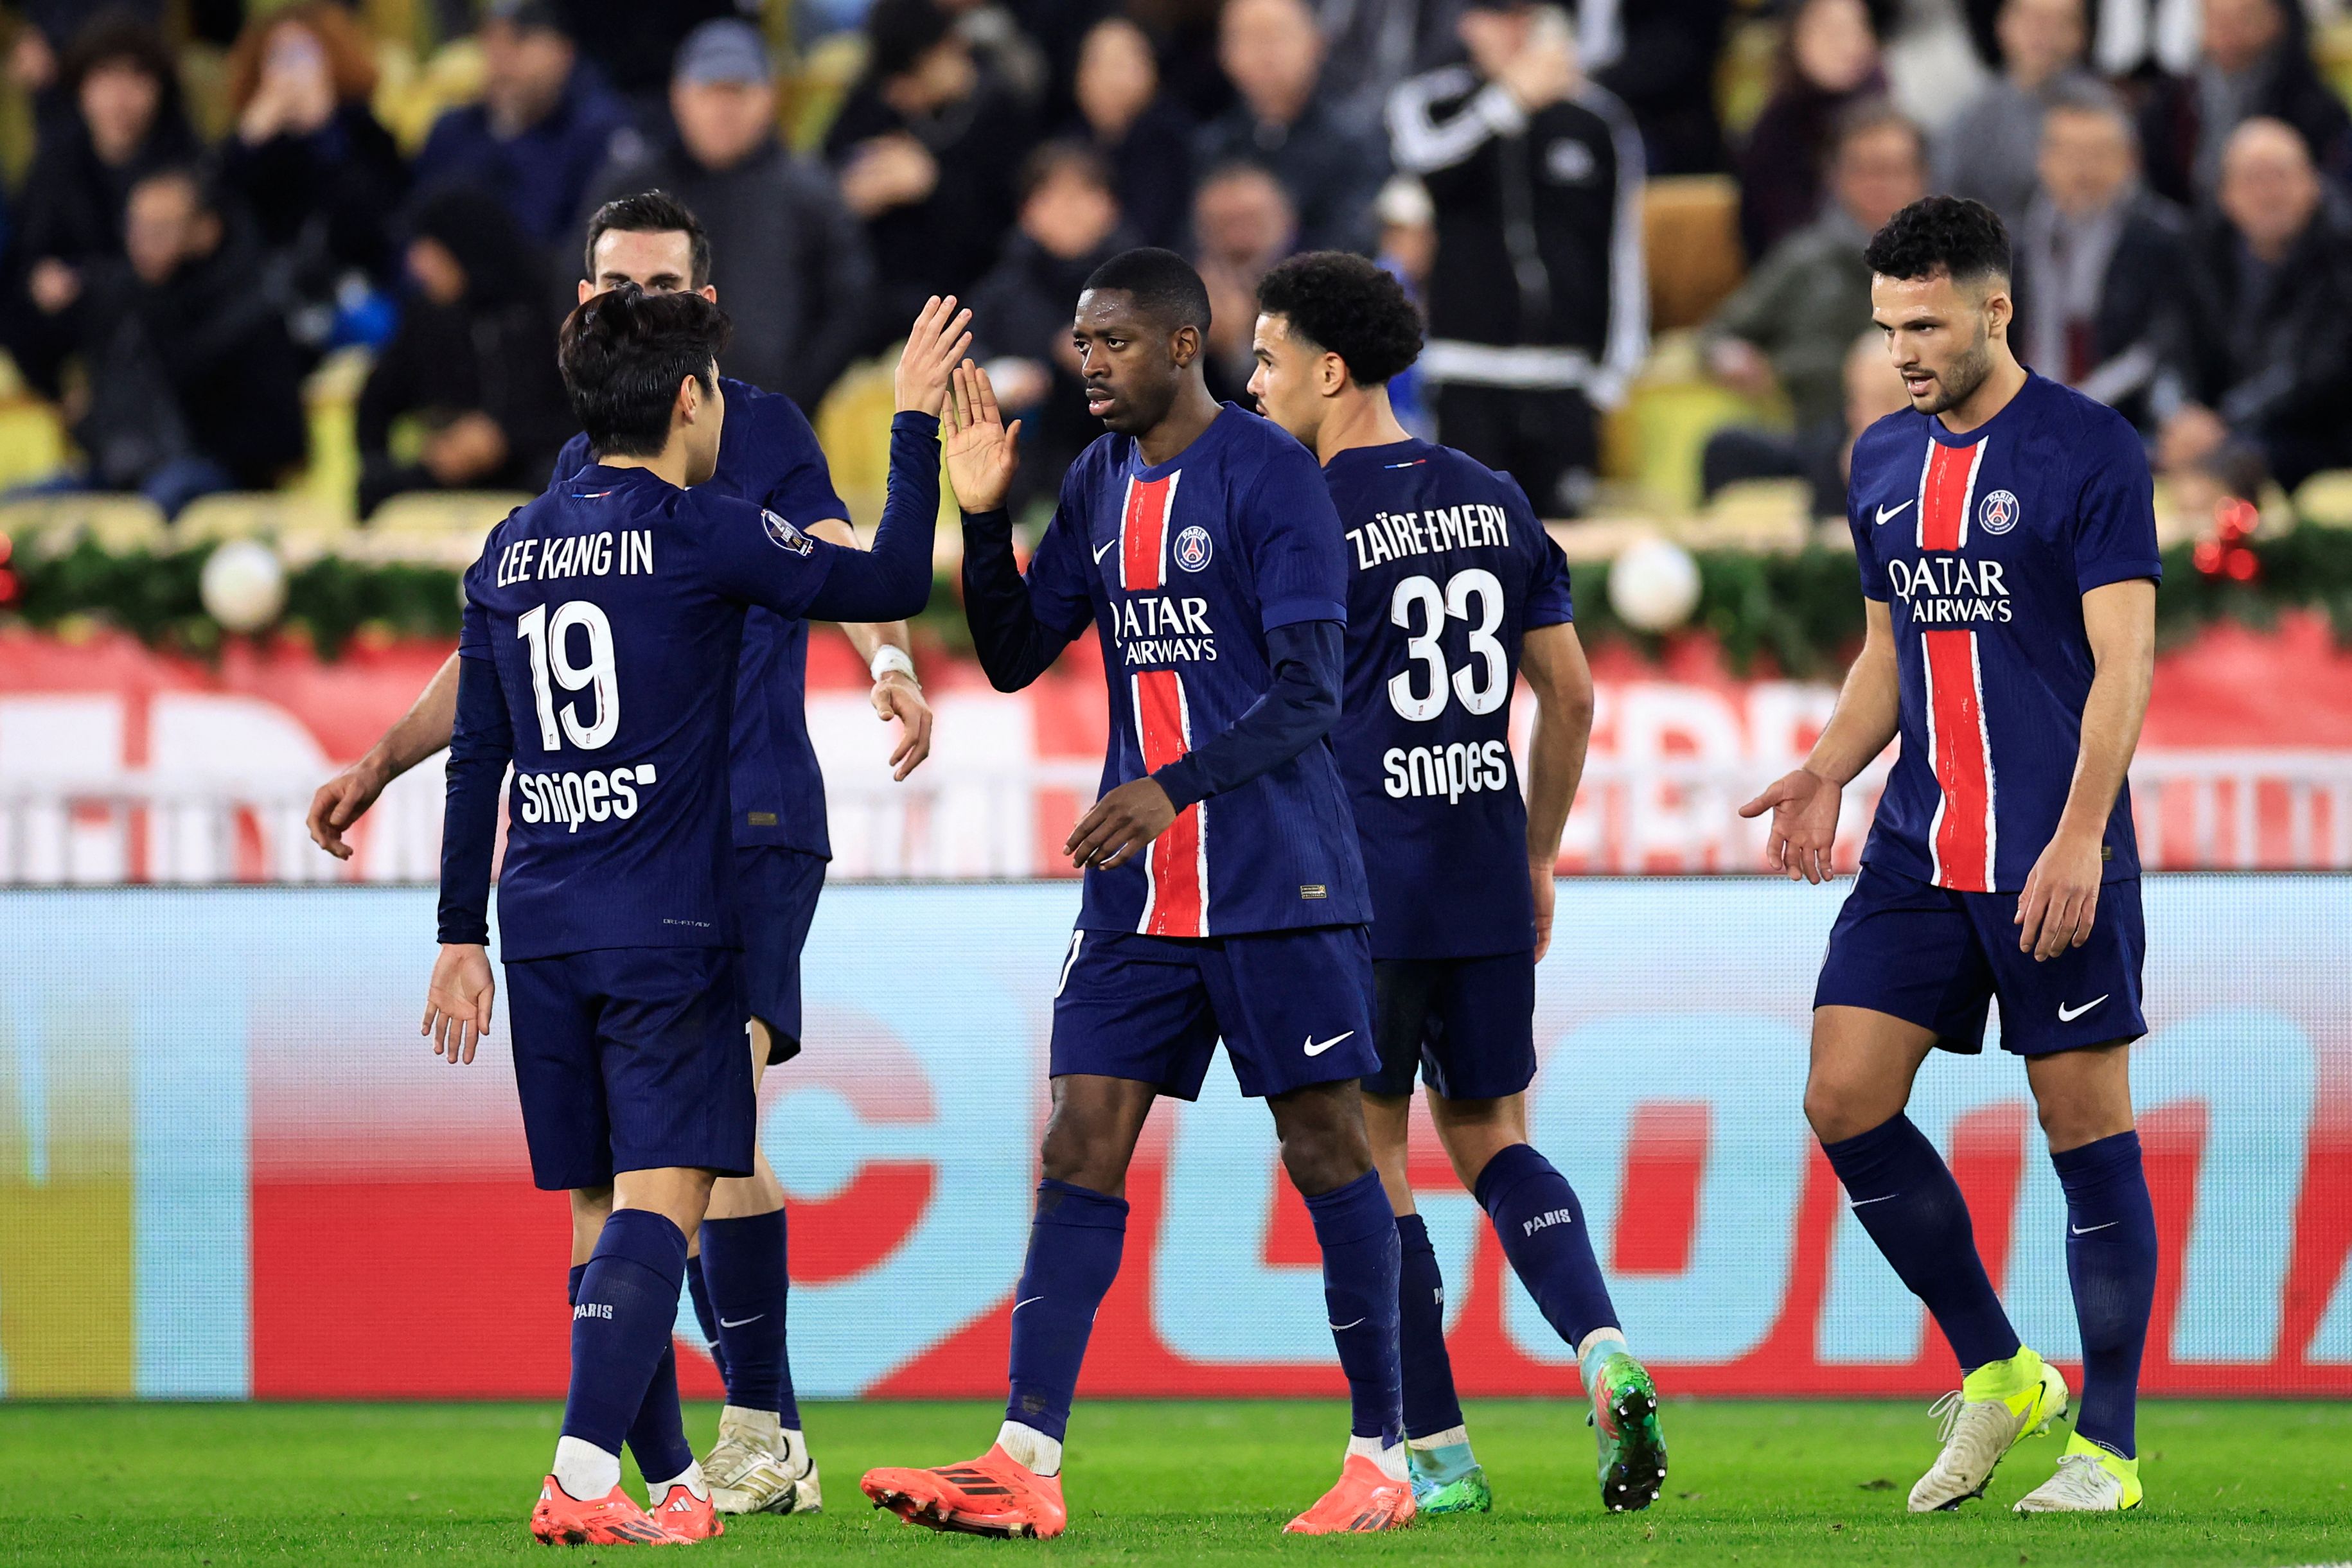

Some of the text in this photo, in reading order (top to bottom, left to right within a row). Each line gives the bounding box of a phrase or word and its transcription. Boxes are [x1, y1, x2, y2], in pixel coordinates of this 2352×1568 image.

[1988, 493, 2014, 504] PARIS
[1182, 528, 1207, 540] PARIS
[1345, 504, 1509, 570] ZAÏRE-EMERY
[497, 530, 653, 588] LEE KANG IN
[1888, 558, 2010, 605] QATAR
[1913, 598, 2012, 622] AIRWAYS
[1125, 639, 1217, 665] AIRWAYS
[1387, 568, 1508, 721] 33
[517, 601, 619, 751] 19
[1383, 740, 1507, 805] snipes
[519, 768, 638, 833] snipes
[1523, 1208, 1571, 1237] PARIS
[573, 1303, 613, 1321] PARIS
